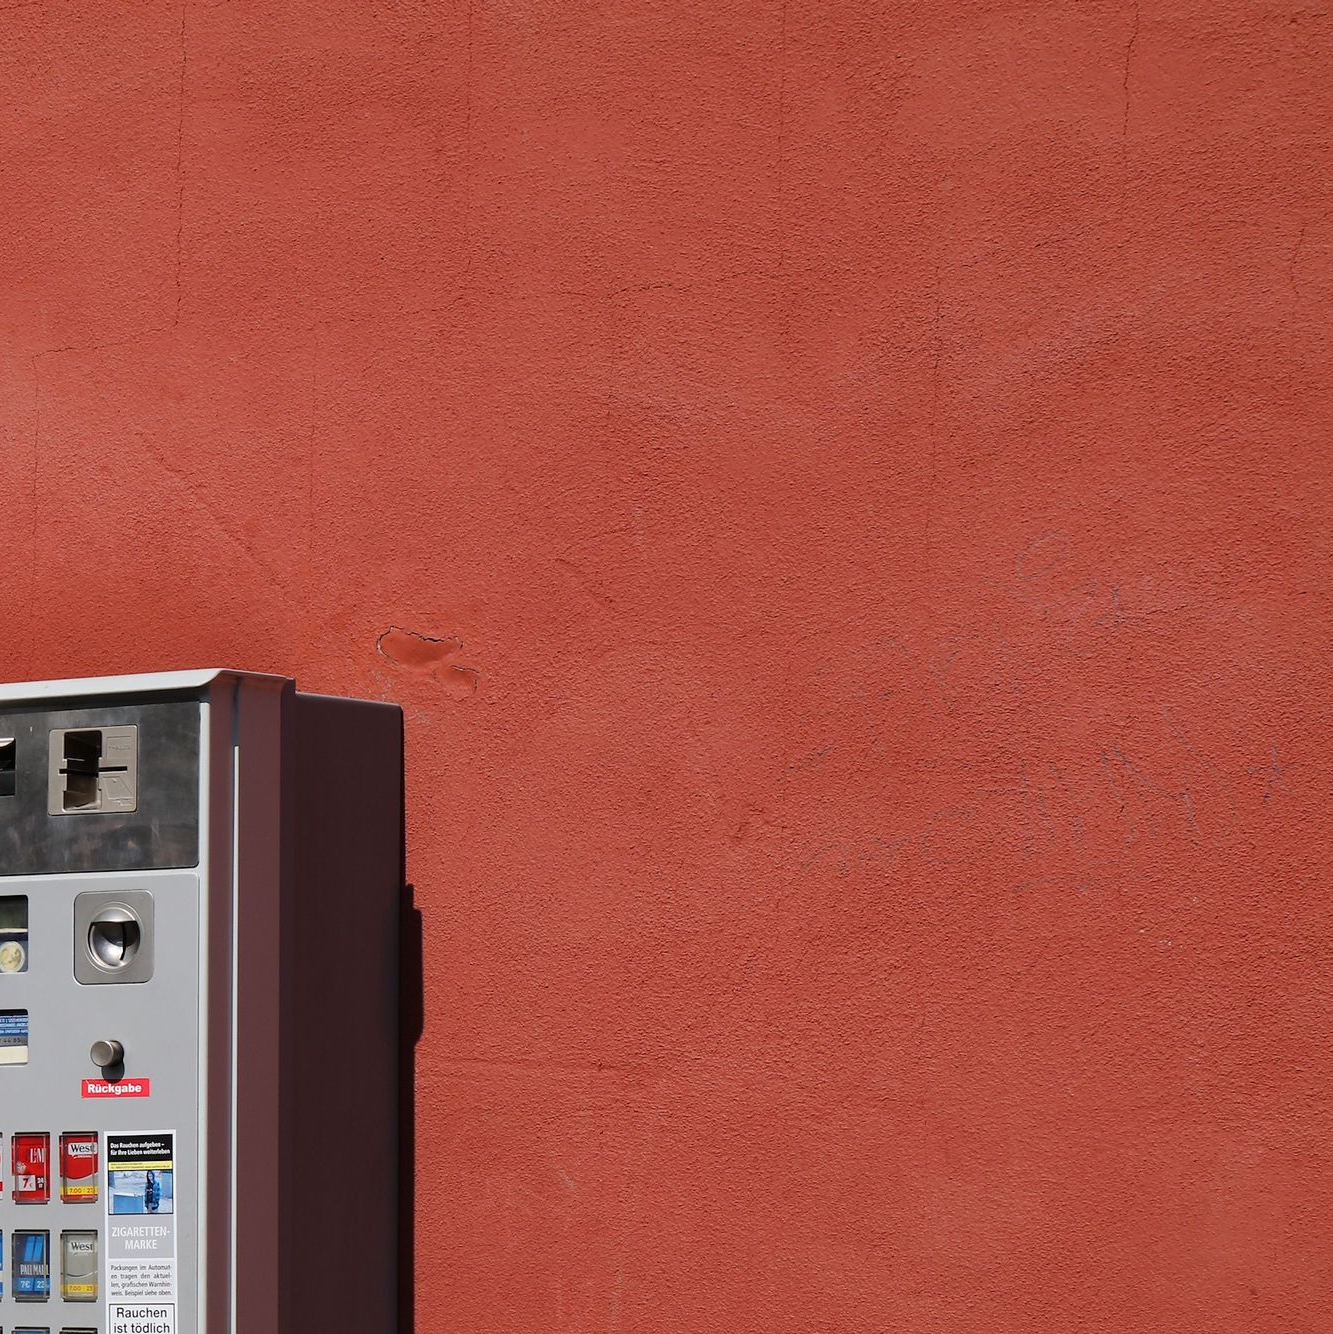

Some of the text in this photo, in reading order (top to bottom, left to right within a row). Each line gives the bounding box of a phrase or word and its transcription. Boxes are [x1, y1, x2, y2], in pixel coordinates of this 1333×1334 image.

[86, 1081, 143, 1096] Rückgabe
[70, 1143, 96, 1153] West
[139, 1141, 161, 1149] aufgeben
[111, 1226, 171, 1238] ZIGARETTEN-
[70, 1241, 94, 1251] West
[124, 1239, 158, 1250] MARKE
[110, 1264, 138, 1272] Packungen
[116, 1307, 168, 1319] Rauchen
[113, 1322, 171, 1334] ist tödlich
